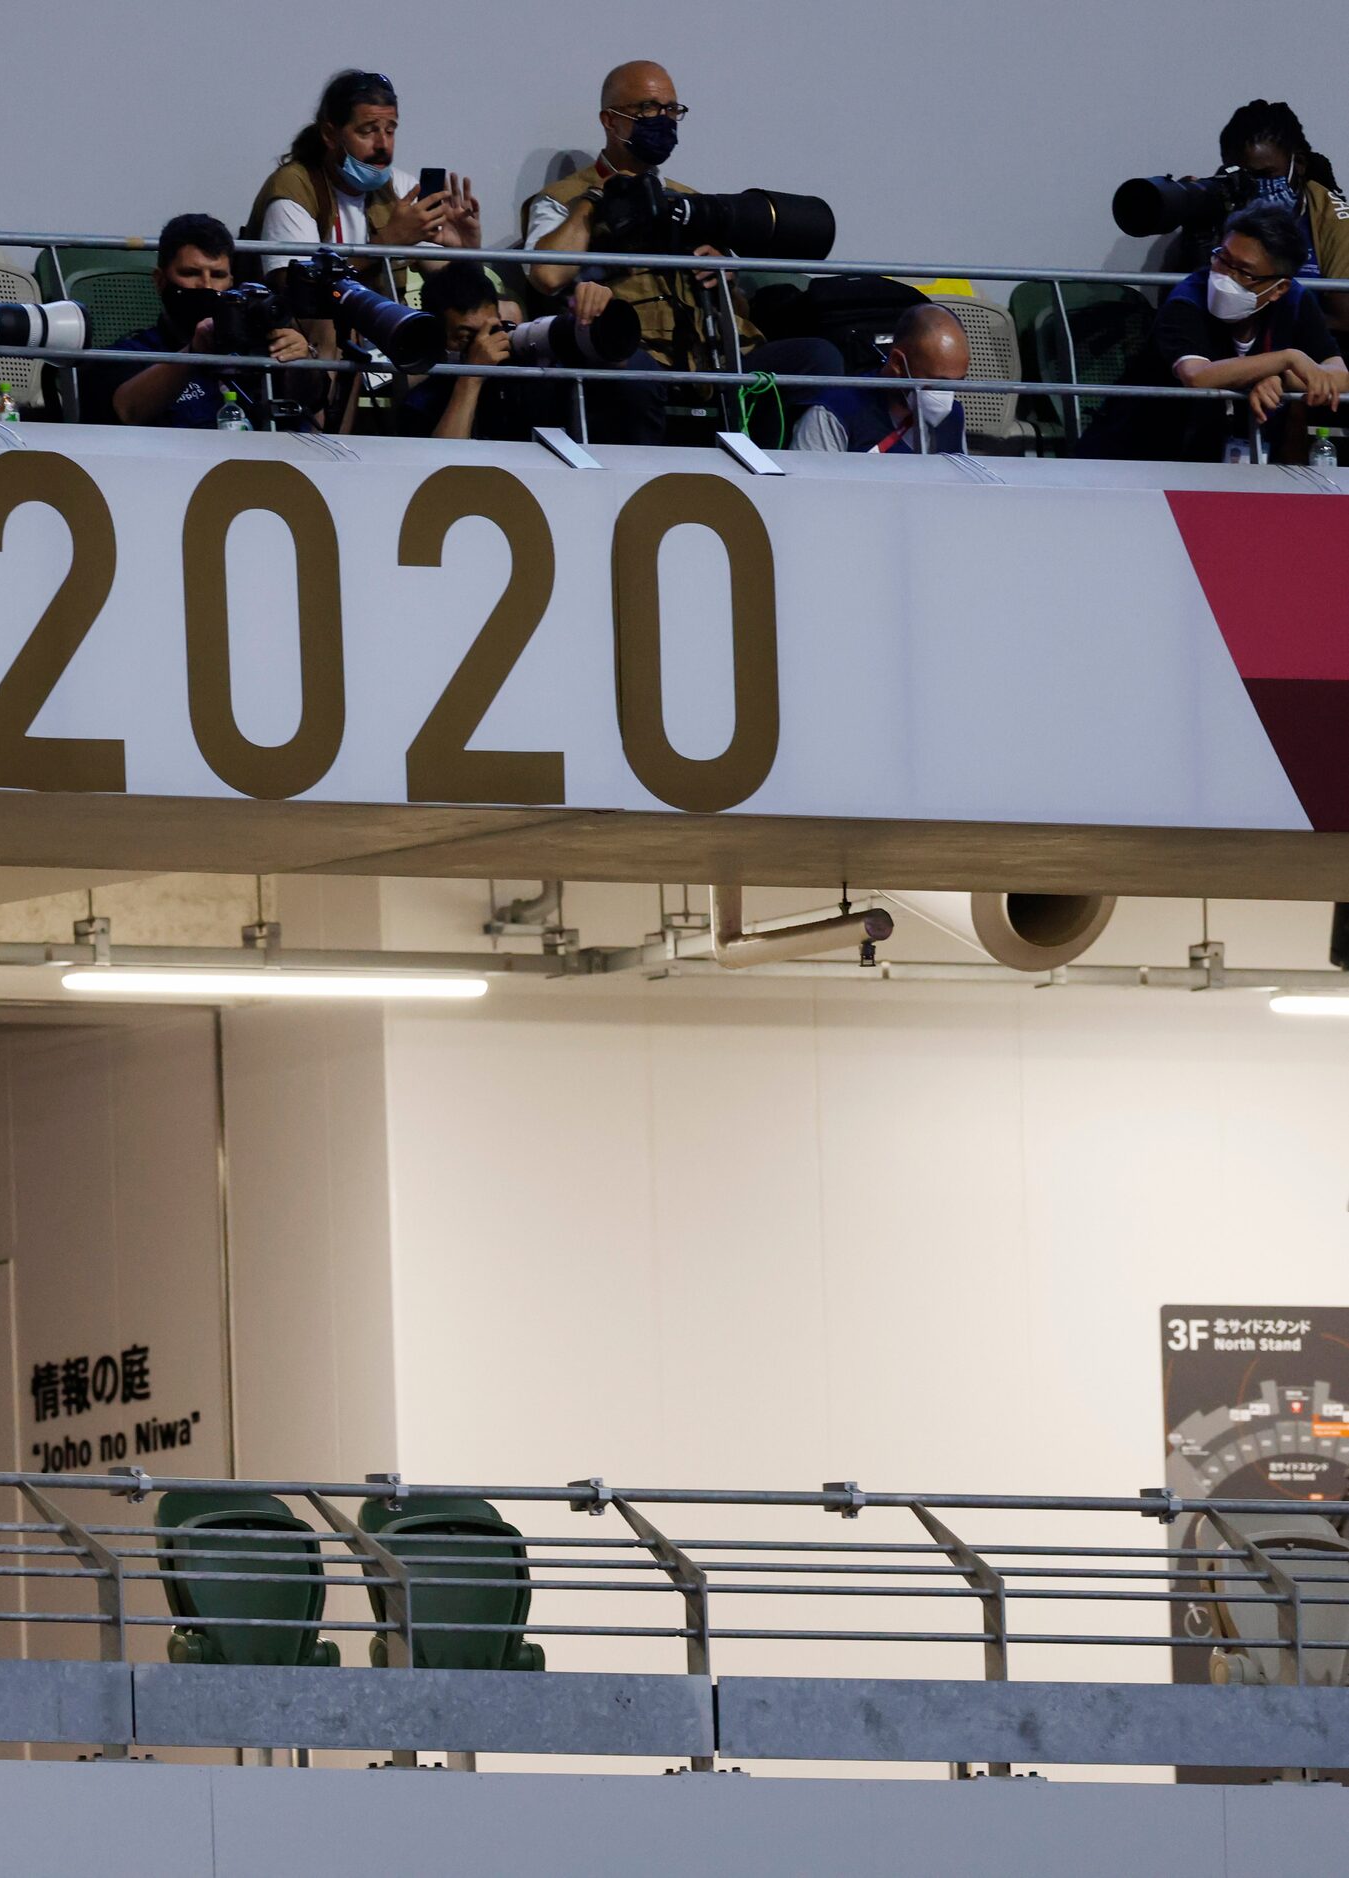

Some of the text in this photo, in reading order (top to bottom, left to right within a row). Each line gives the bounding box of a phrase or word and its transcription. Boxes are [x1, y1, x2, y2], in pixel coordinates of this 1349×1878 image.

[1167, 1318, 1209, 1351] 3F
[1214, 1337, 1302, 1352] North Stand
[31, 1344, 151, 1422] 情報の庭
[100, 1432, 127, 1462] no
